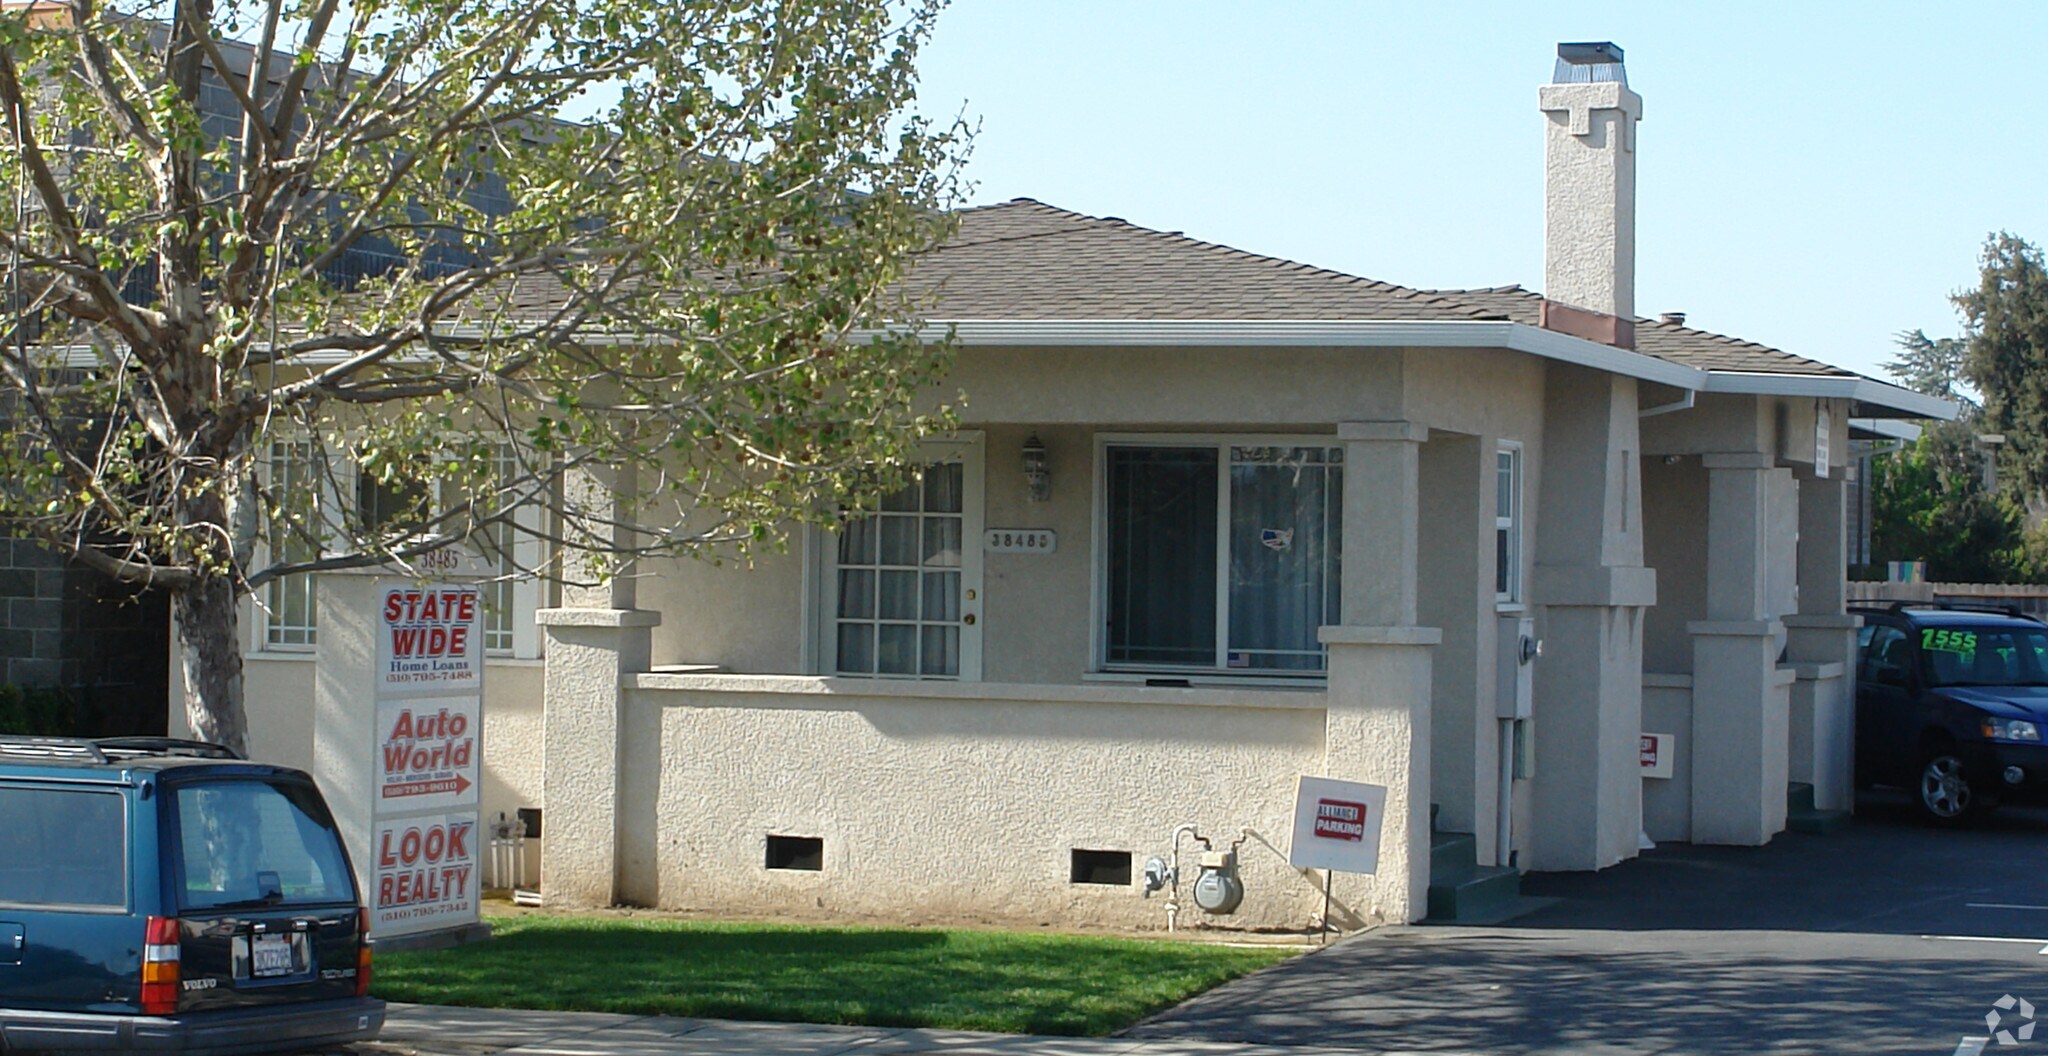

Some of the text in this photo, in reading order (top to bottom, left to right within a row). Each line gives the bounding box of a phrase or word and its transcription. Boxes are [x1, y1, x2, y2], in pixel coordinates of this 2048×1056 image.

[991, 533, 1047, 547] 38485
[384, 589, 477, 624] STATE
[391, 624, 468, 660] WIDE
[390, 660, 469, 672] Home Loans
[387, 708, 468, 744] Auto
[382, 737, 474, 775] World
[1316, 819, 1362, 835] PARKING
[378, 821, 474, 870] LOOK
[377, 863, 473, 910] REALTY
[381, 911, 411, 922] (510)
[182, 978, 217, 990] VOLVO
